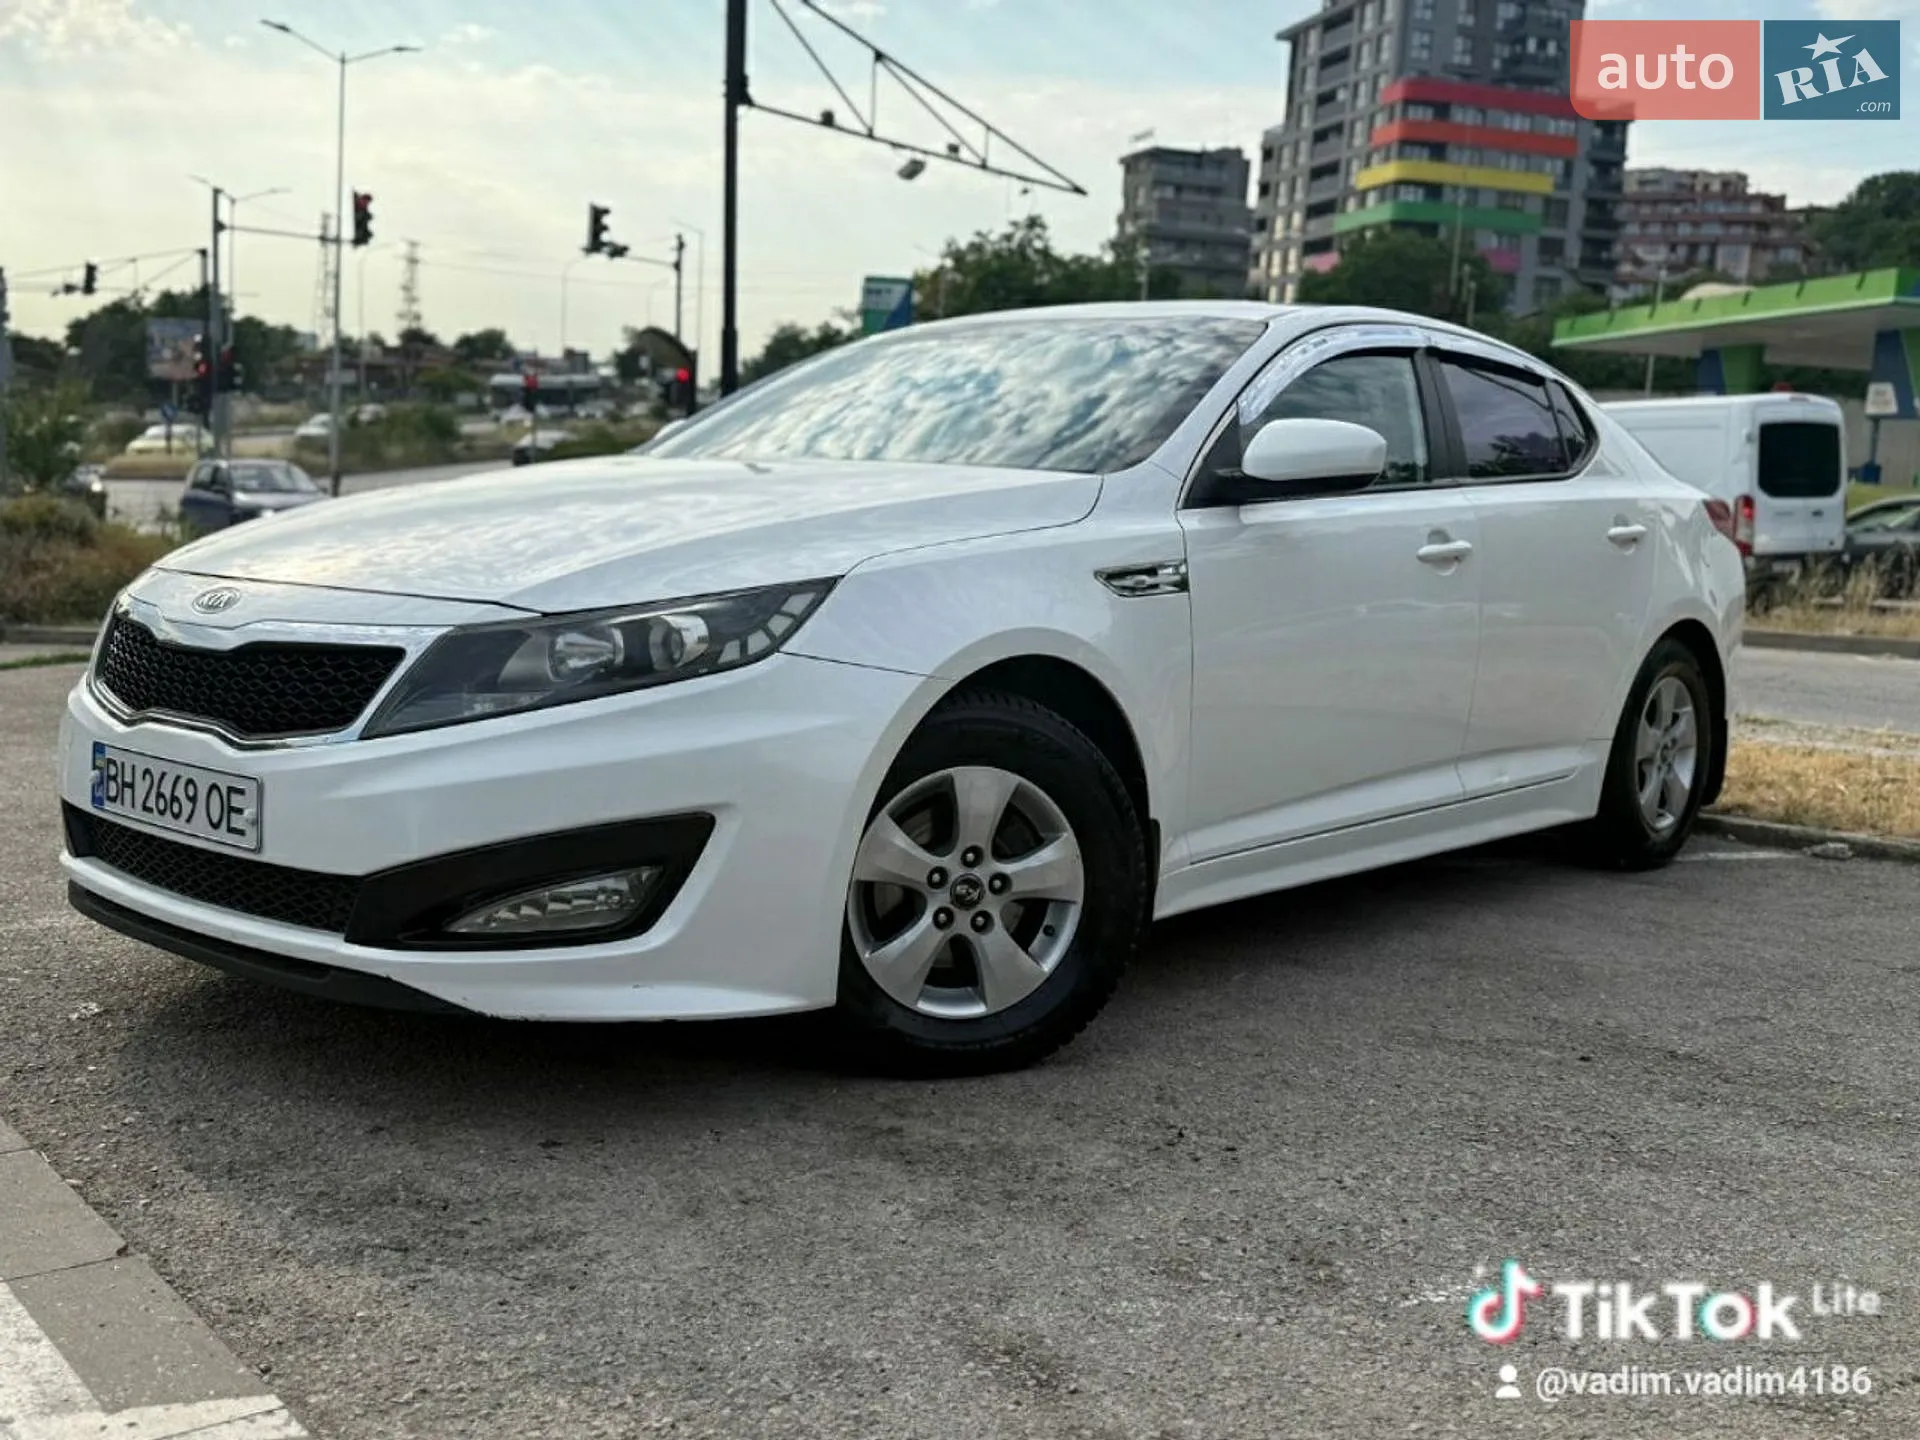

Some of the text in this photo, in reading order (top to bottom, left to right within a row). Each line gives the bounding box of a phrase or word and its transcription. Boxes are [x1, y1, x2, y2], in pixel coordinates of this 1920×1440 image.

[106, 757, 247, 837] BH 2669 OE
